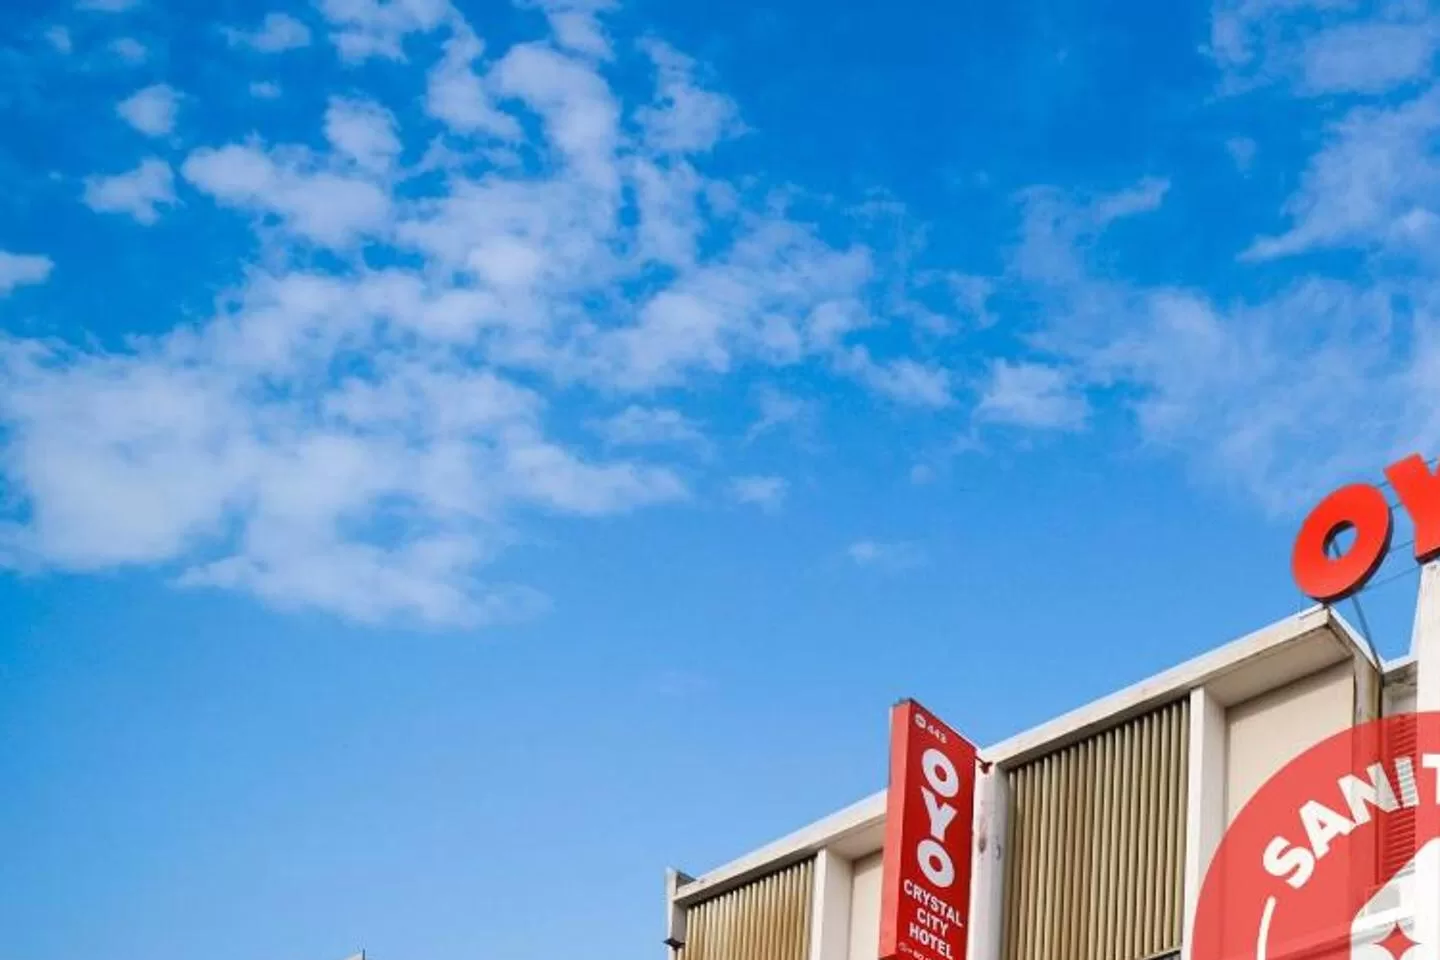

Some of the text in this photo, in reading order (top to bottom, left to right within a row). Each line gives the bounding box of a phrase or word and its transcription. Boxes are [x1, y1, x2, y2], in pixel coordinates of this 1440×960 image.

[917, 748, 960, 888] OYO
[903, 879, 963, 927] CRYSTAL
[917, 908, 949, 937] CITY
[909, 922, 954, 960] HOTEL
